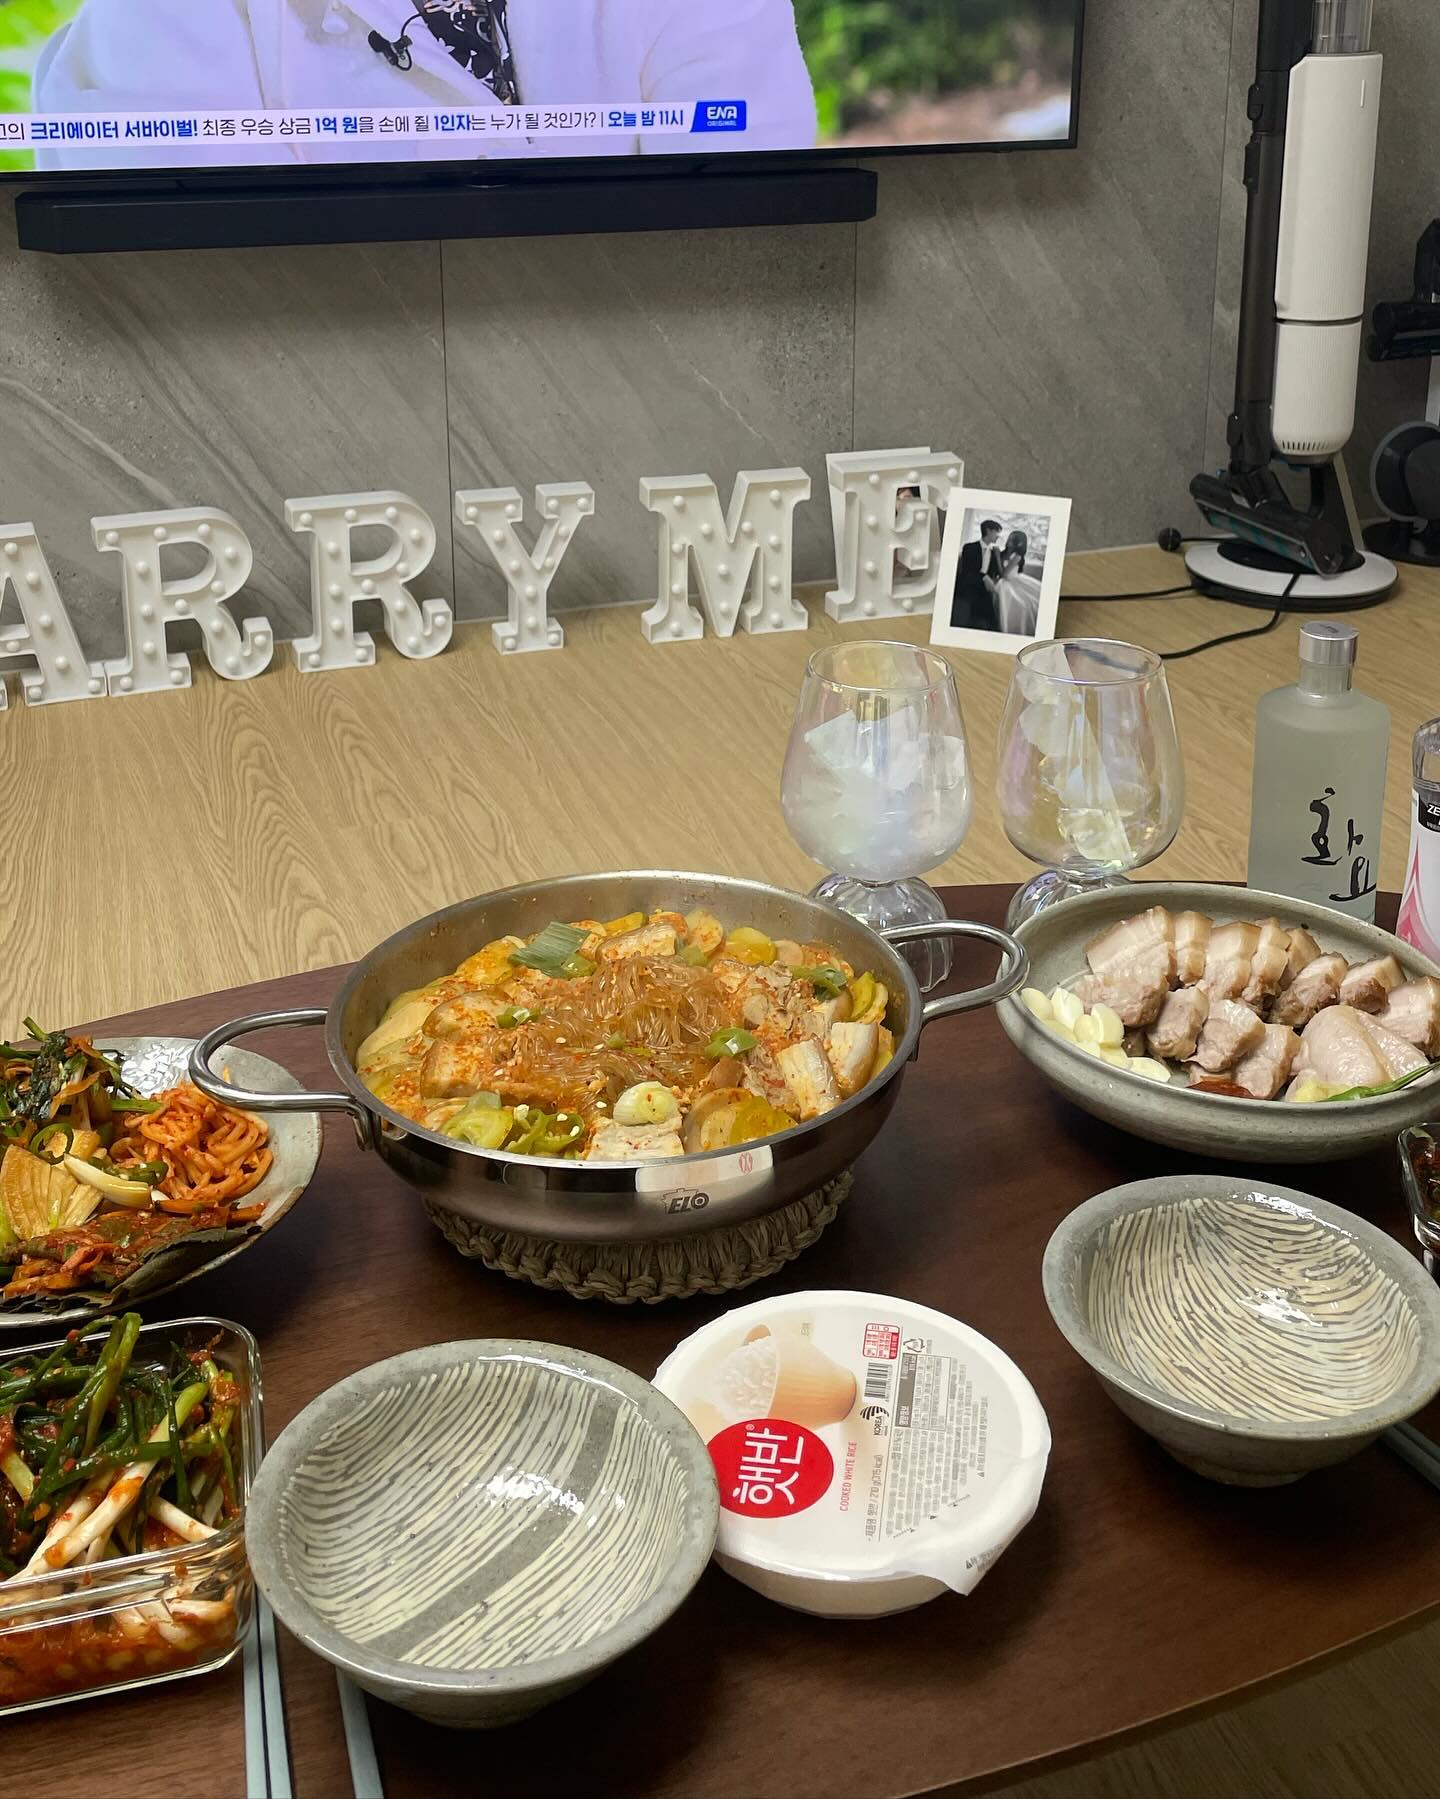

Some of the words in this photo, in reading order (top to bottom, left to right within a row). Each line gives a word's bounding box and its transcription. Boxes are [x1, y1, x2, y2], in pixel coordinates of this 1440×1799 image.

[706, 105, 738, 120] ENA
[706, 119, 738, 128] ORIGINAL
[31, 121, 119, 140] 크리에이터
[125, 119, 198, 138] 서바이벌!
[202, 119, 236, 137] 최종
[240, 118, 274, 136] 우승
[278, 117, 312, 136] 상금
[315, 116, 338, 134] 1억
[342, 116, 374, 134] 원을
[378, 115, 410, 133] 손에
[414, 115, 430, 132] 쥘
[433, 114, 487, 131] 1인자는
[490, 113, 520, 131] 누가
[525, 112, 540, 130] 될
[543, 111, 597, 129] 것인가?
[607, 110, 638, 127] 오늘
[641, 110, 656, 127] 밤
[658, 109, 684, 126] 11시
[640, 450, 965, 643] ME
[668, 1192, 710, 1214] ELO
[873, 1415, 883, 1437] KOREA
[847, 1441, 858, 1458] RICE
[732, 1427, 805, 1506] 햇반
[844, 1459, 855, 1481] WHITE
[840, 1482, 852, 1512] COOKED
